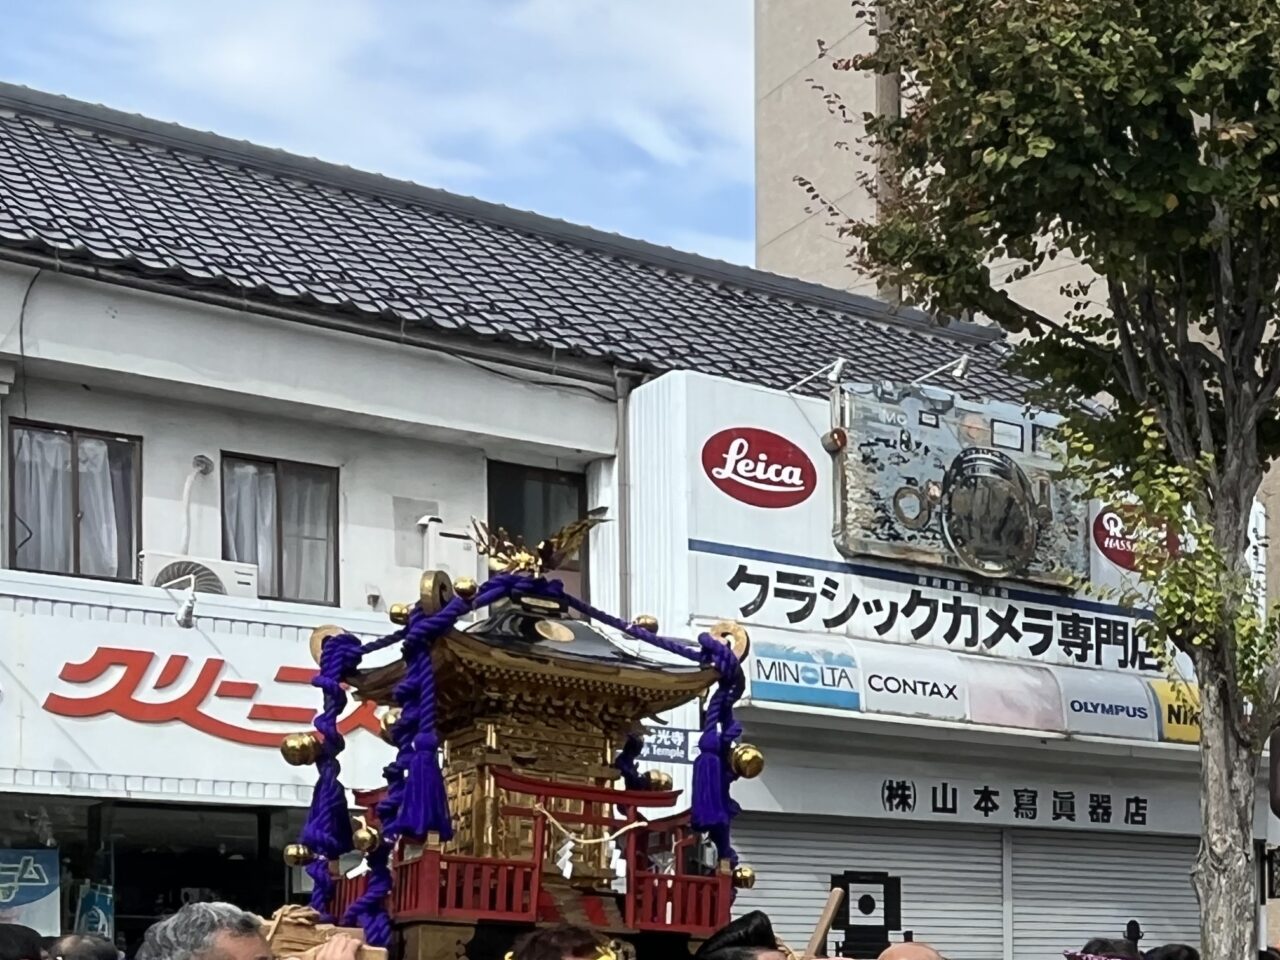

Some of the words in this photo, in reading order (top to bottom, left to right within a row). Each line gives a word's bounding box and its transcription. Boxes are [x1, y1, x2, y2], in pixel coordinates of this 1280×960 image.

[711, 437, 805, 492] Leica
[726, 563, 1166, 674] クラシックカメラ専門店
[756, 657, 854, 690] MINOLTA
[868, 674, 959, 701] CONTAX
[1070, 699, 1149, 721] OLYMPUS
[1167, 703, 1201, 726] Nik
[652, 744, 685, 759] Temple
